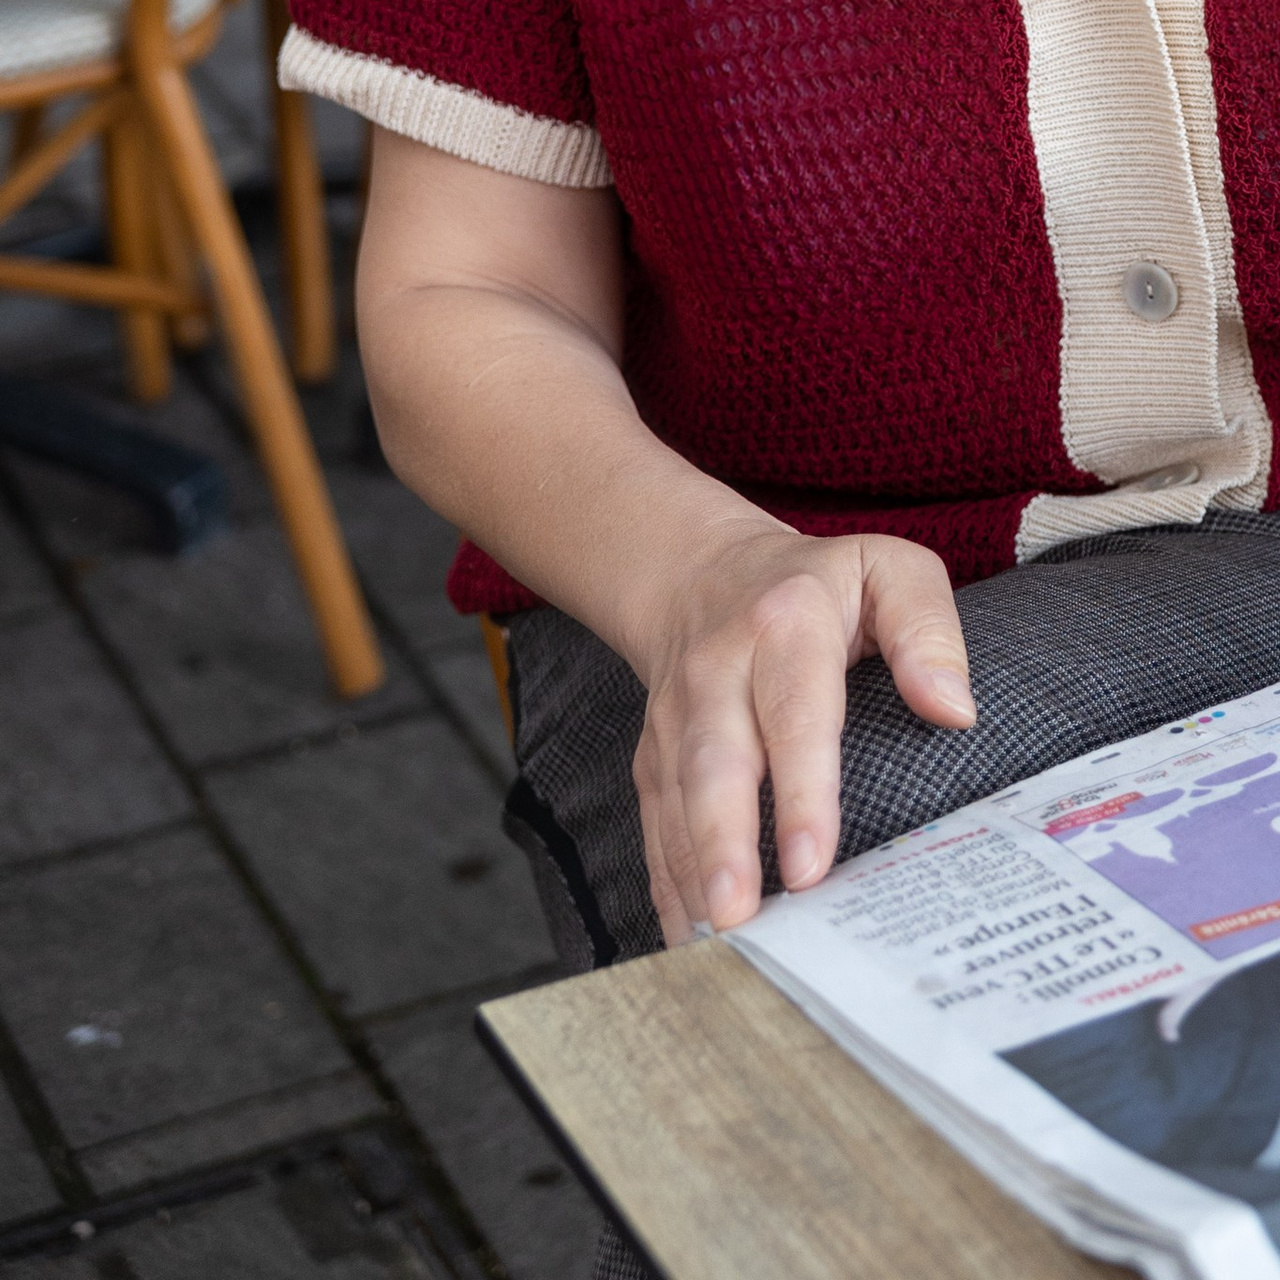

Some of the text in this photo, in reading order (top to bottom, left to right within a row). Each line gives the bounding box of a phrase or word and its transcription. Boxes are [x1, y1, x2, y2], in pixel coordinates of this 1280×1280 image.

[946, 887, 1099, 957] l'Europe
[954, 906, 1119, 979] retrouver
[1067, 933, 1121, 961] Le
[926, 974, 1007, 1013] veut
[998, 949, 1080, 989] TFC
[1029, 942, 1167, 1004] Comolli
